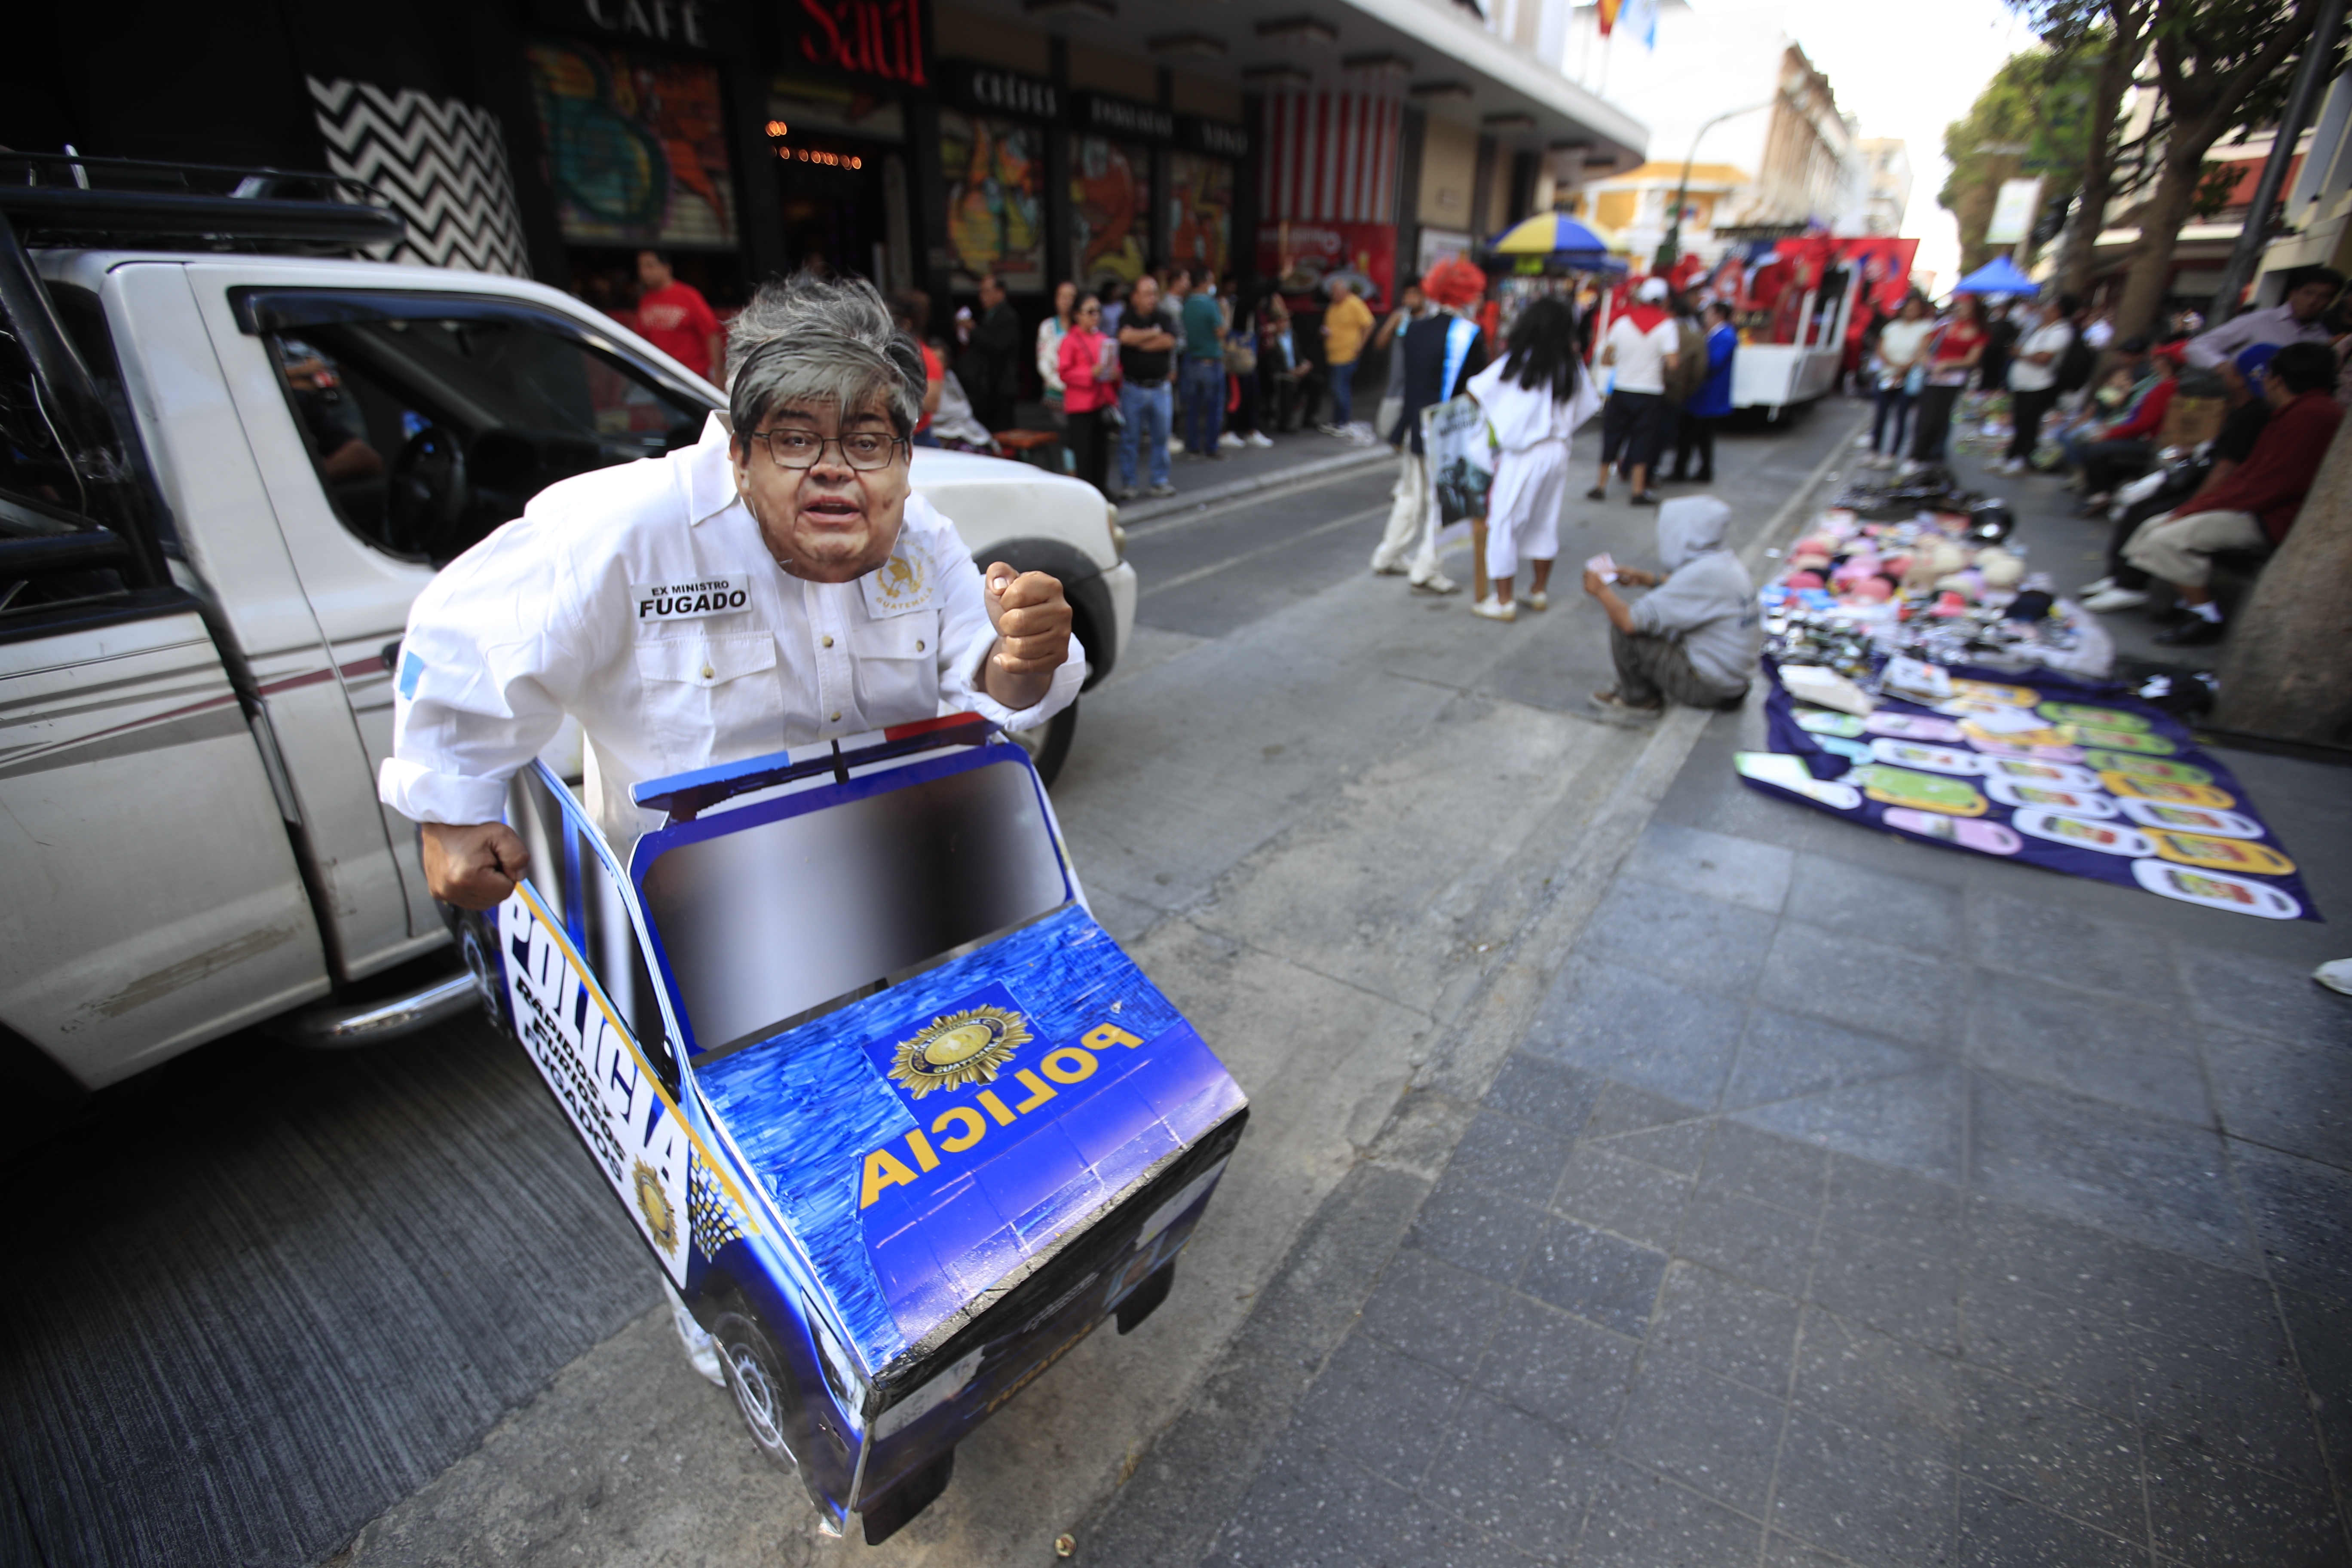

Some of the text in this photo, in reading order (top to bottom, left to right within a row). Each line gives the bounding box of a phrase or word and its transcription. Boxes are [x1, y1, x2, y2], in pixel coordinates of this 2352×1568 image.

[640, 590, 746, 617] FUGADO
[652, 581, 729, 596] EX MINISTRO
[876, 587, 934, 609] GUATEMALA
[933, 1036, 1003, 1073] GUATEMALA
[525, 1021, 623, 1183] FUGADOS
[533, 1017, 627, 1162] FURIOSOS
